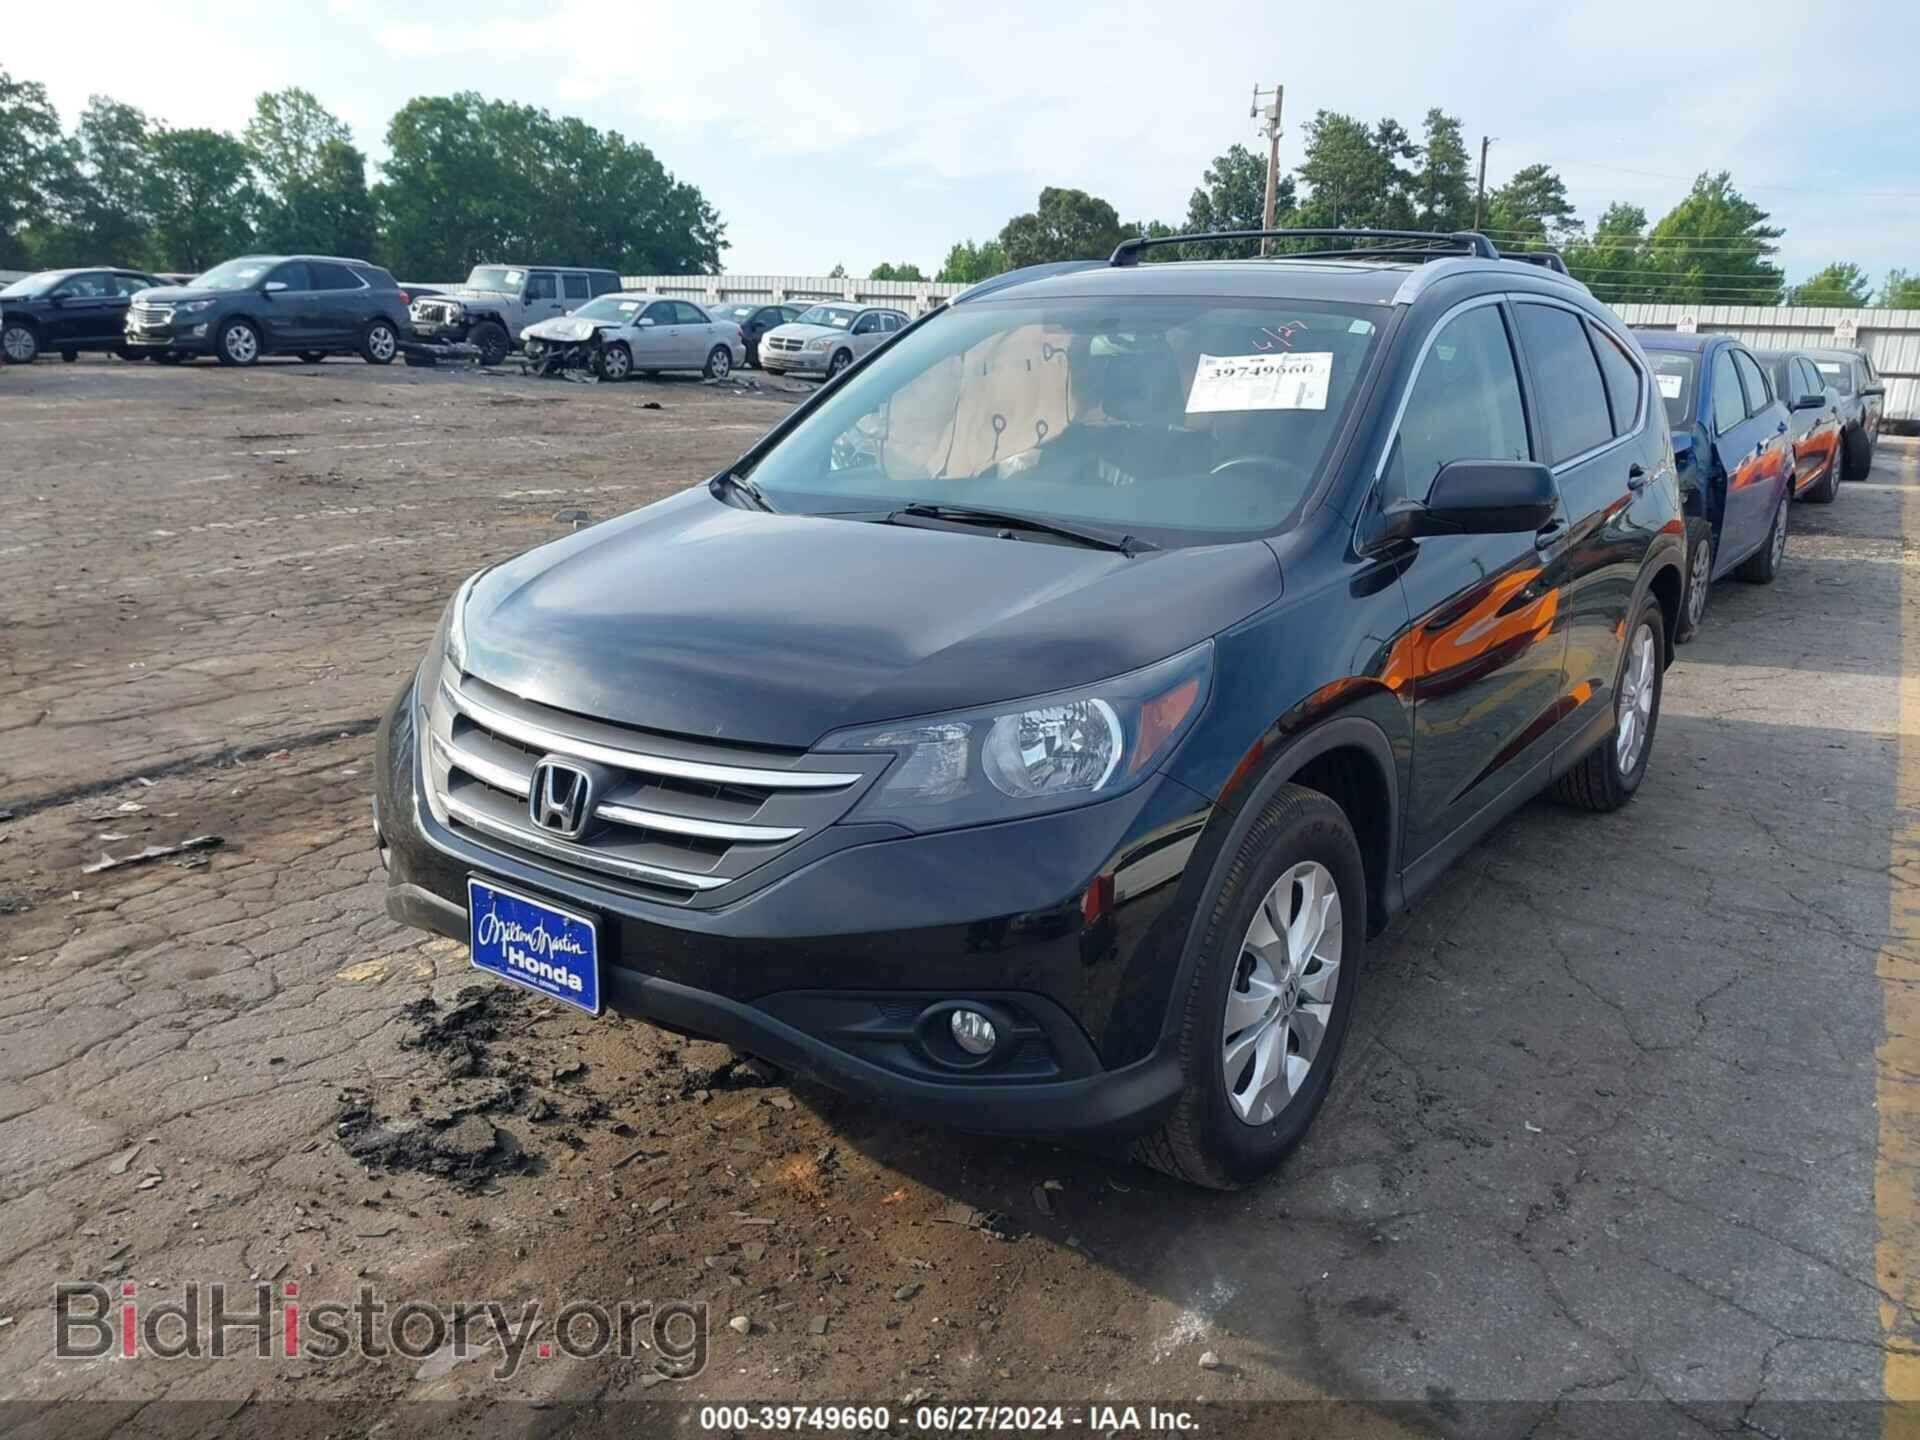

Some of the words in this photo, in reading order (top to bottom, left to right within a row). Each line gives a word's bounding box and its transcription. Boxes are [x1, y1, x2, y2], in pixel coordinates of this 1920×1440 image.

[534, 762, 588, 836] H
[478, 901, 532, 958] Milton
[531, 917, 587, 960] Martin
[508, 946, 583, 992] Honda
